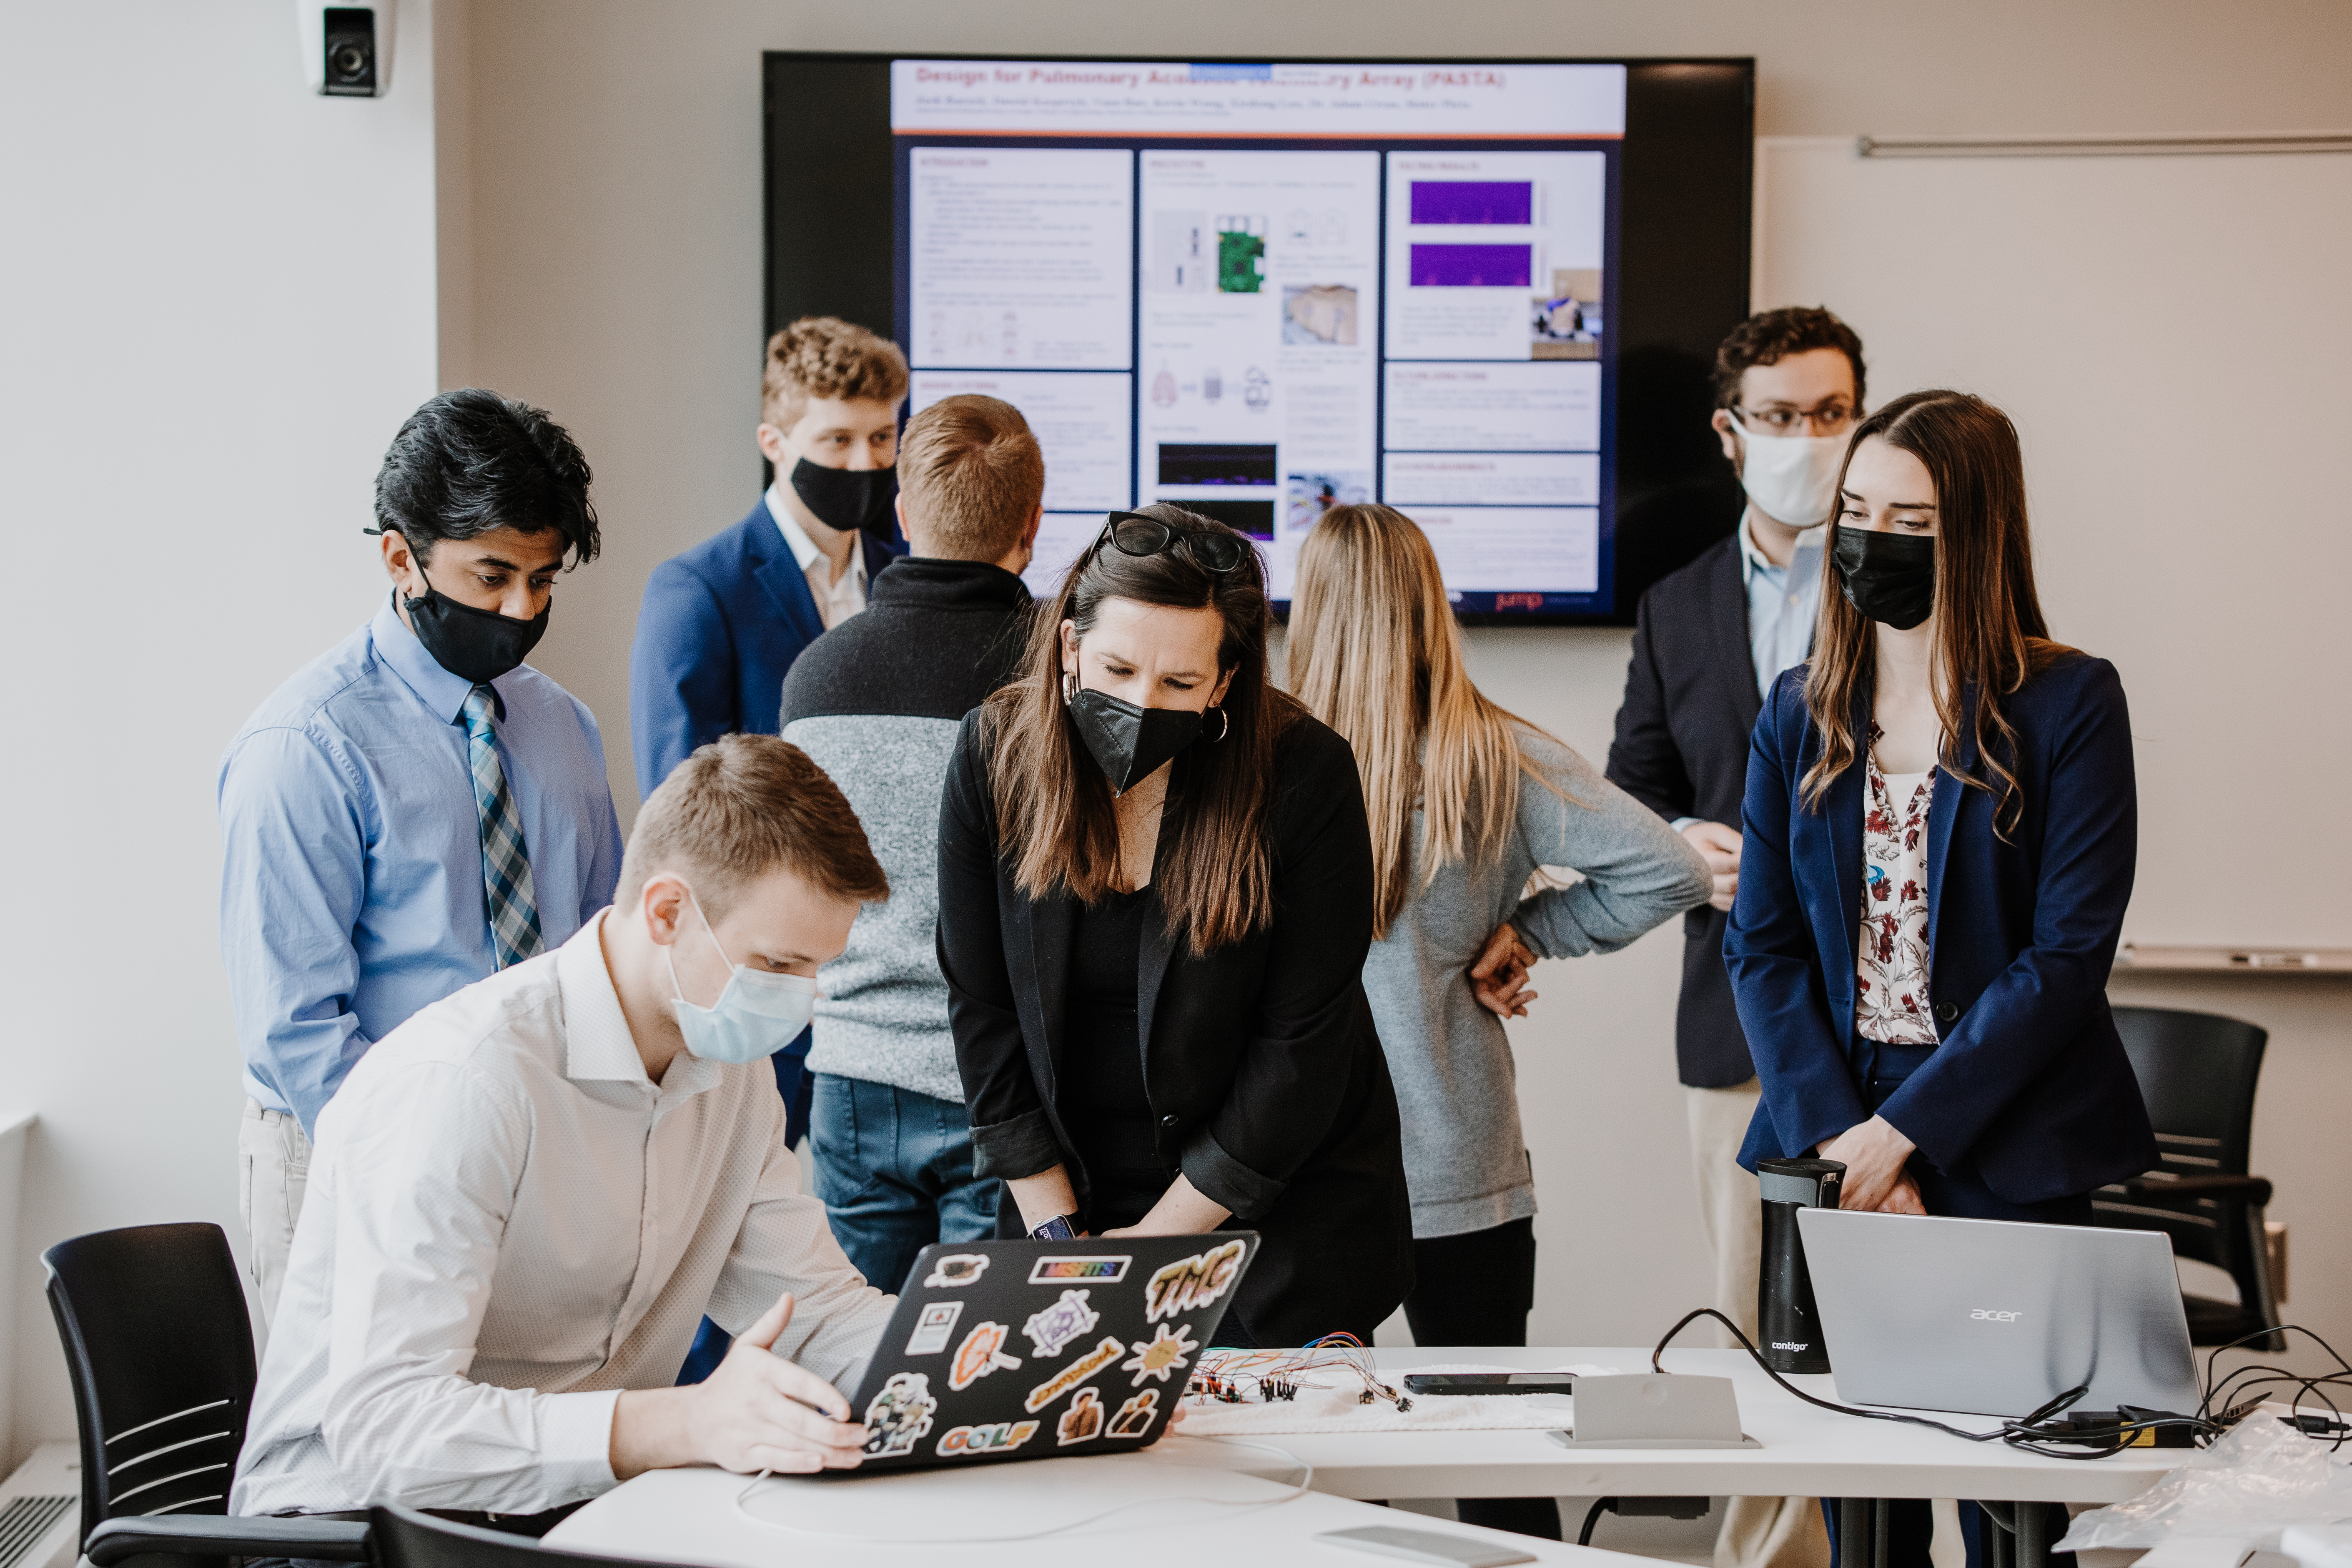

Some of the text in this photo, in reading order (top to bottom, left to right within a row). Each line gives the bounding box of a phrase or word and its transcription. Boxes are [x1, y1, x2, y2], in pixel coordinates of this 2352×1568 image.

[916, 67, 987, 87] Design
[994, 68, 1022, 83] for
[1029, 68, 1138, 88] Pulmonary
[1360, 70, 1414, 90] Array
[1423, 70, 1506, 90] (PASTA)
[1040, 1227, 1049, 1239] 10:12
[1970, 1309, 2022, 1322] acer
[1772, 1342, 1806, 1352] contigo
[943, 1425, 1033, 1451] GOLF
